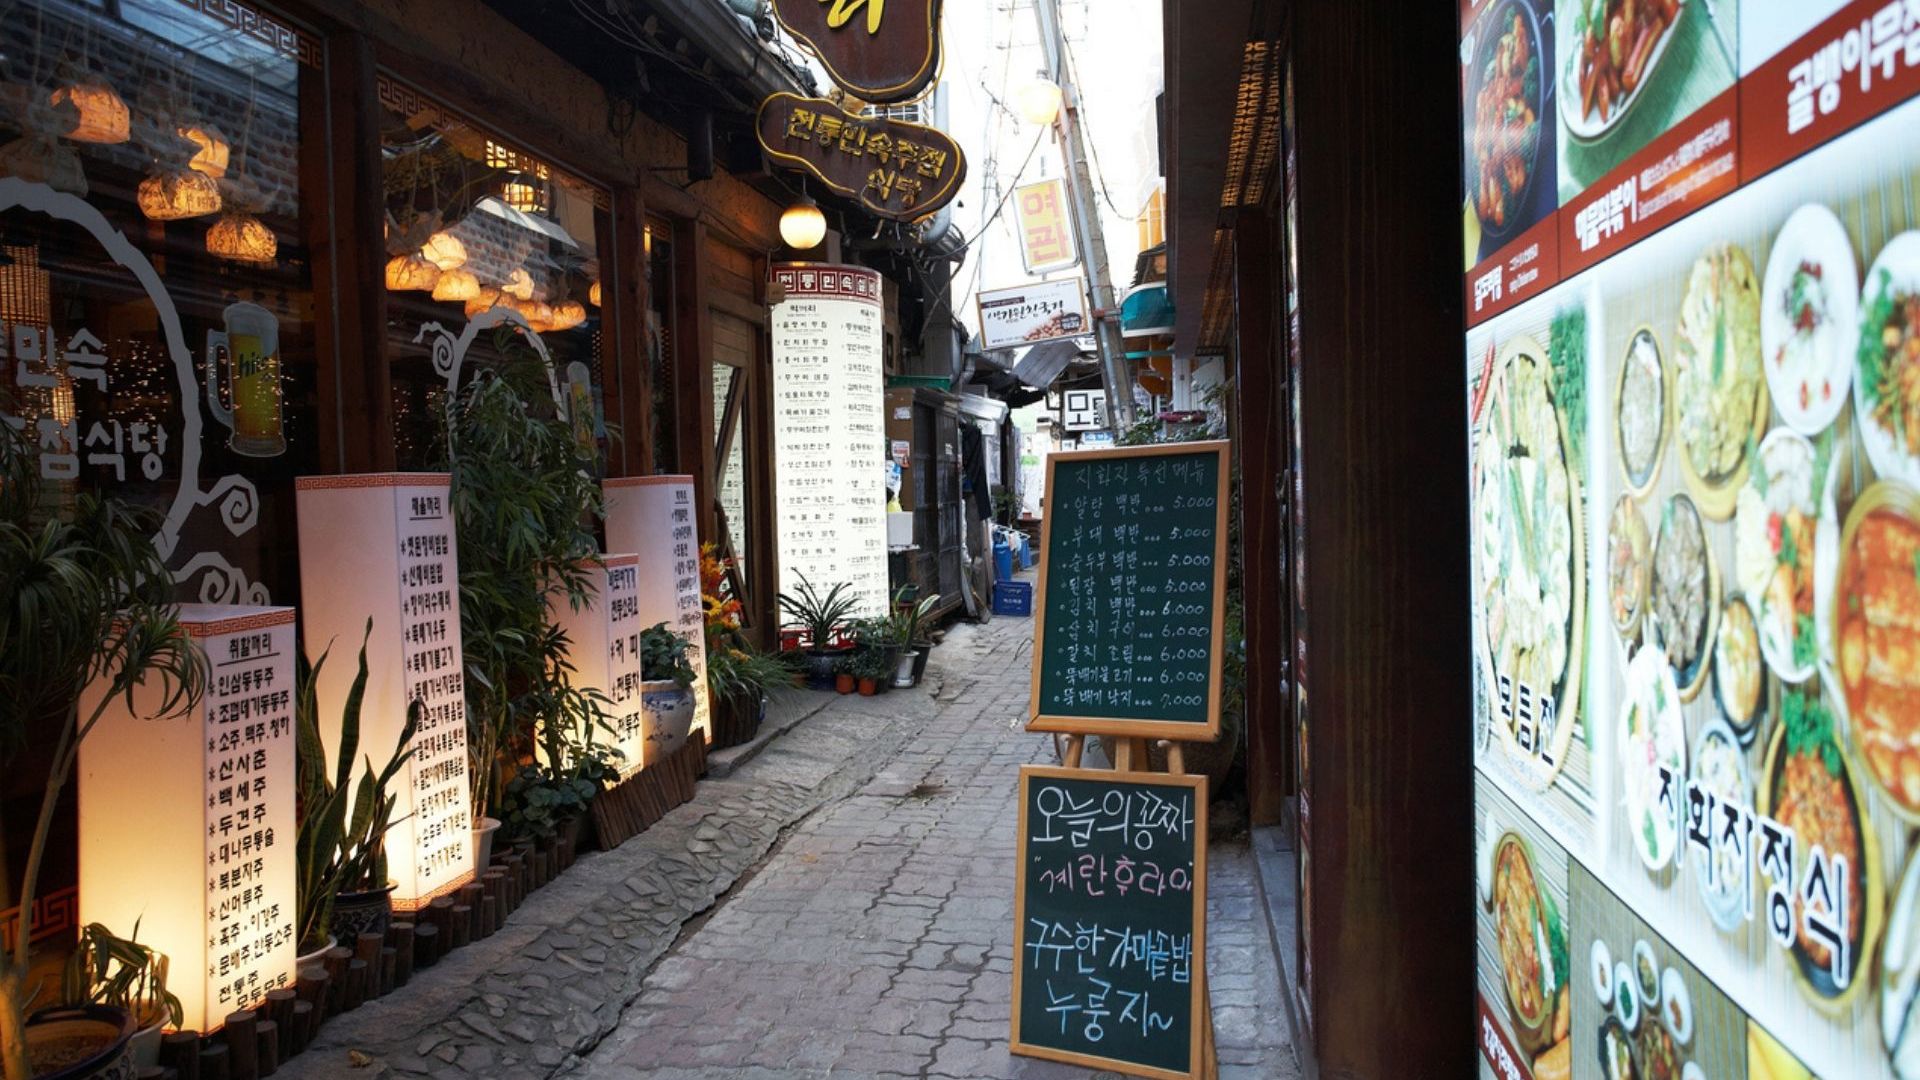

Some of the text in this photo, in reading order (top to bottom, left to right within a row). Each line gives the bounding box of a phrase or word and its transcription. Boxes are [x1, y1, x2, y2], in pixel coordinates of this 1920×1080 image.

[786, 107, 947, 179] 전통민속주점
[866, 168, 923, 208] 식당
[1115, 493, 1141, 514] 백반
[1172, 496, 1215, 509] 5.000
[1072, 524, 1212, 547] 부대 백반 5.000
[1069, 551, 1211, 573] 순두부 백반 5.000
[1069, 574, 1207, 596] 된장 백반 5.000
[1070, 596, 1205, 620] 김치 백반 6.000
[1068, 619, 1209, 641] 삼치 구이 6.000
[228, 633, 272, 659] 취할꺼리
[615, 634, 639, 664] 커피
[1068, 643, 1097, 663] 갈치
[1160, 646, 1207, 662] 6.000
[218, 667, 274, 696] 인삼동동주
[616, 671, 641, 702] 전통차
[1160, 668, 1205, 684] 6.000
[1108, 688, 1132, 708] 낙지
[618, 711, 641, 745] 전통주
[1499, 674, 1557, 767] 모듬전
[219, 777, 267, 807] 백세주
[219, 803, 267, 838] 두견주
[1032, 786, 1131, 848] 오늘의
[220, 827, 274, 865] 대나무통술
[220, 857, 264, 890] 복분자주
[1658, 765, 1849, 990] 지화자정식
[220, 884, 264, 921] 산머루주
[250, 904, 280, 932] 이강주
[1026, 918, 1193, 983] 구수한 가마솥밥
[219, 970, 259, 1004] 전통주
